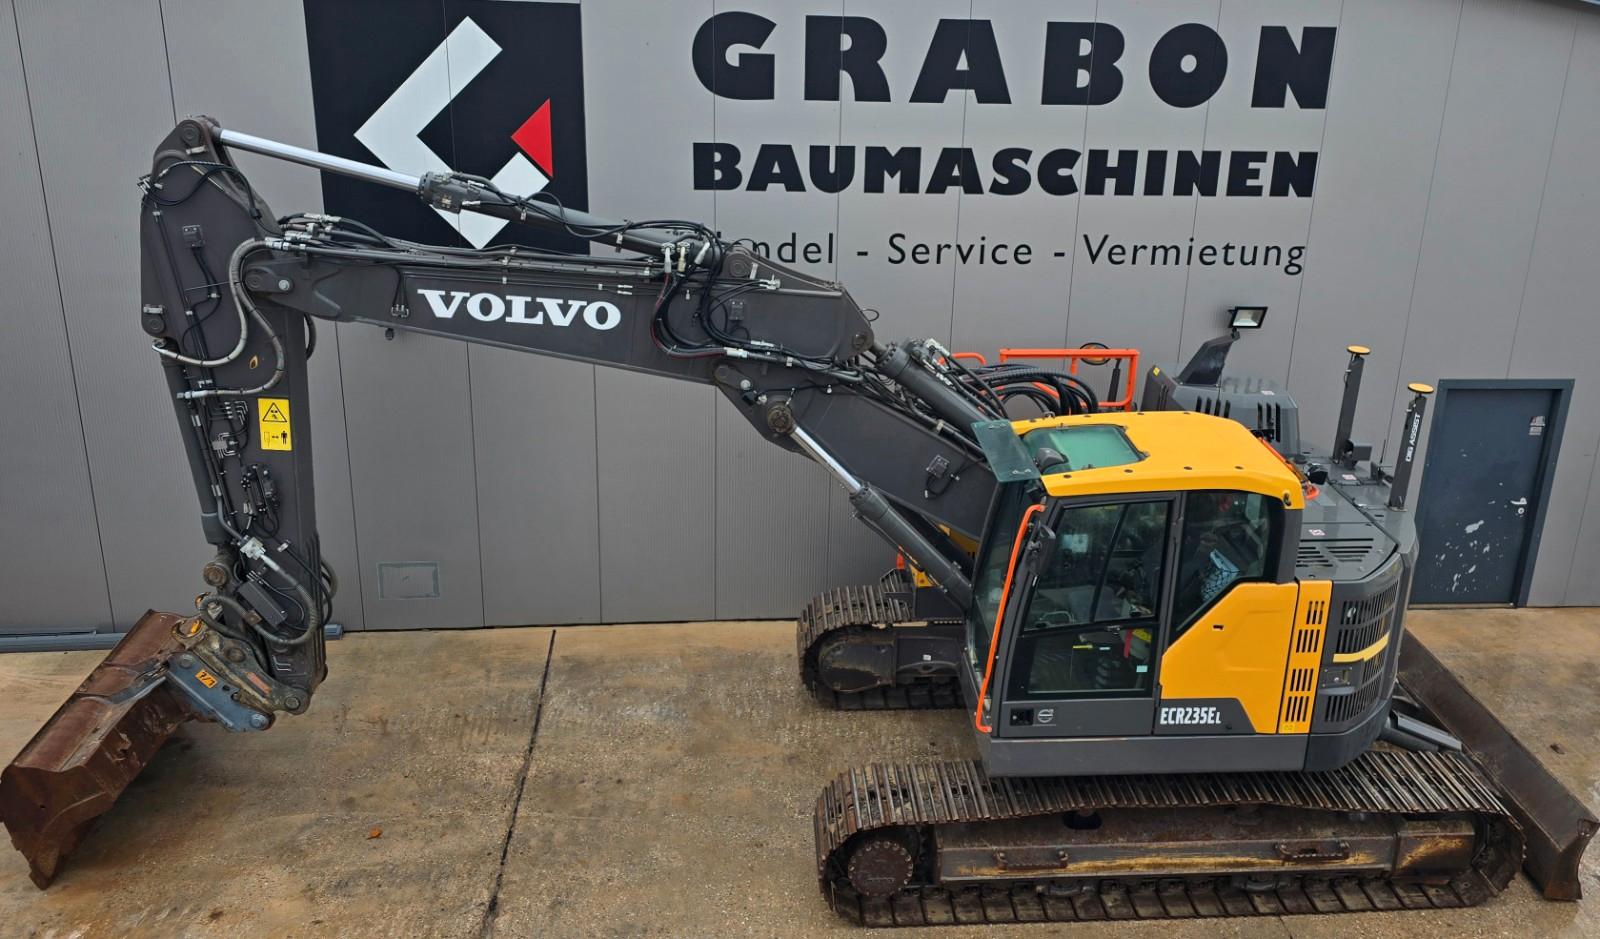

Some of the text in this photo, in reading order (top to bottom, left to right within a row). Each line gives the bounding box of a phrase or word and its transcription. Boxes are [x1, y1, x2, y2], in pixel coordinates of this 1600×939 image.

[692, 12, 1337, 109] GRABON
[693, 143, 1318, 197] BAUMASCHINEN
[717, 231, 834, 264] ndel
[888, 233, 1032, 265] Service
[1083, 234, 1306, 276] Vermietung
[418, 289, 621, 330] VOLVO
[1409, 412, 1421, 446] ASSIST
